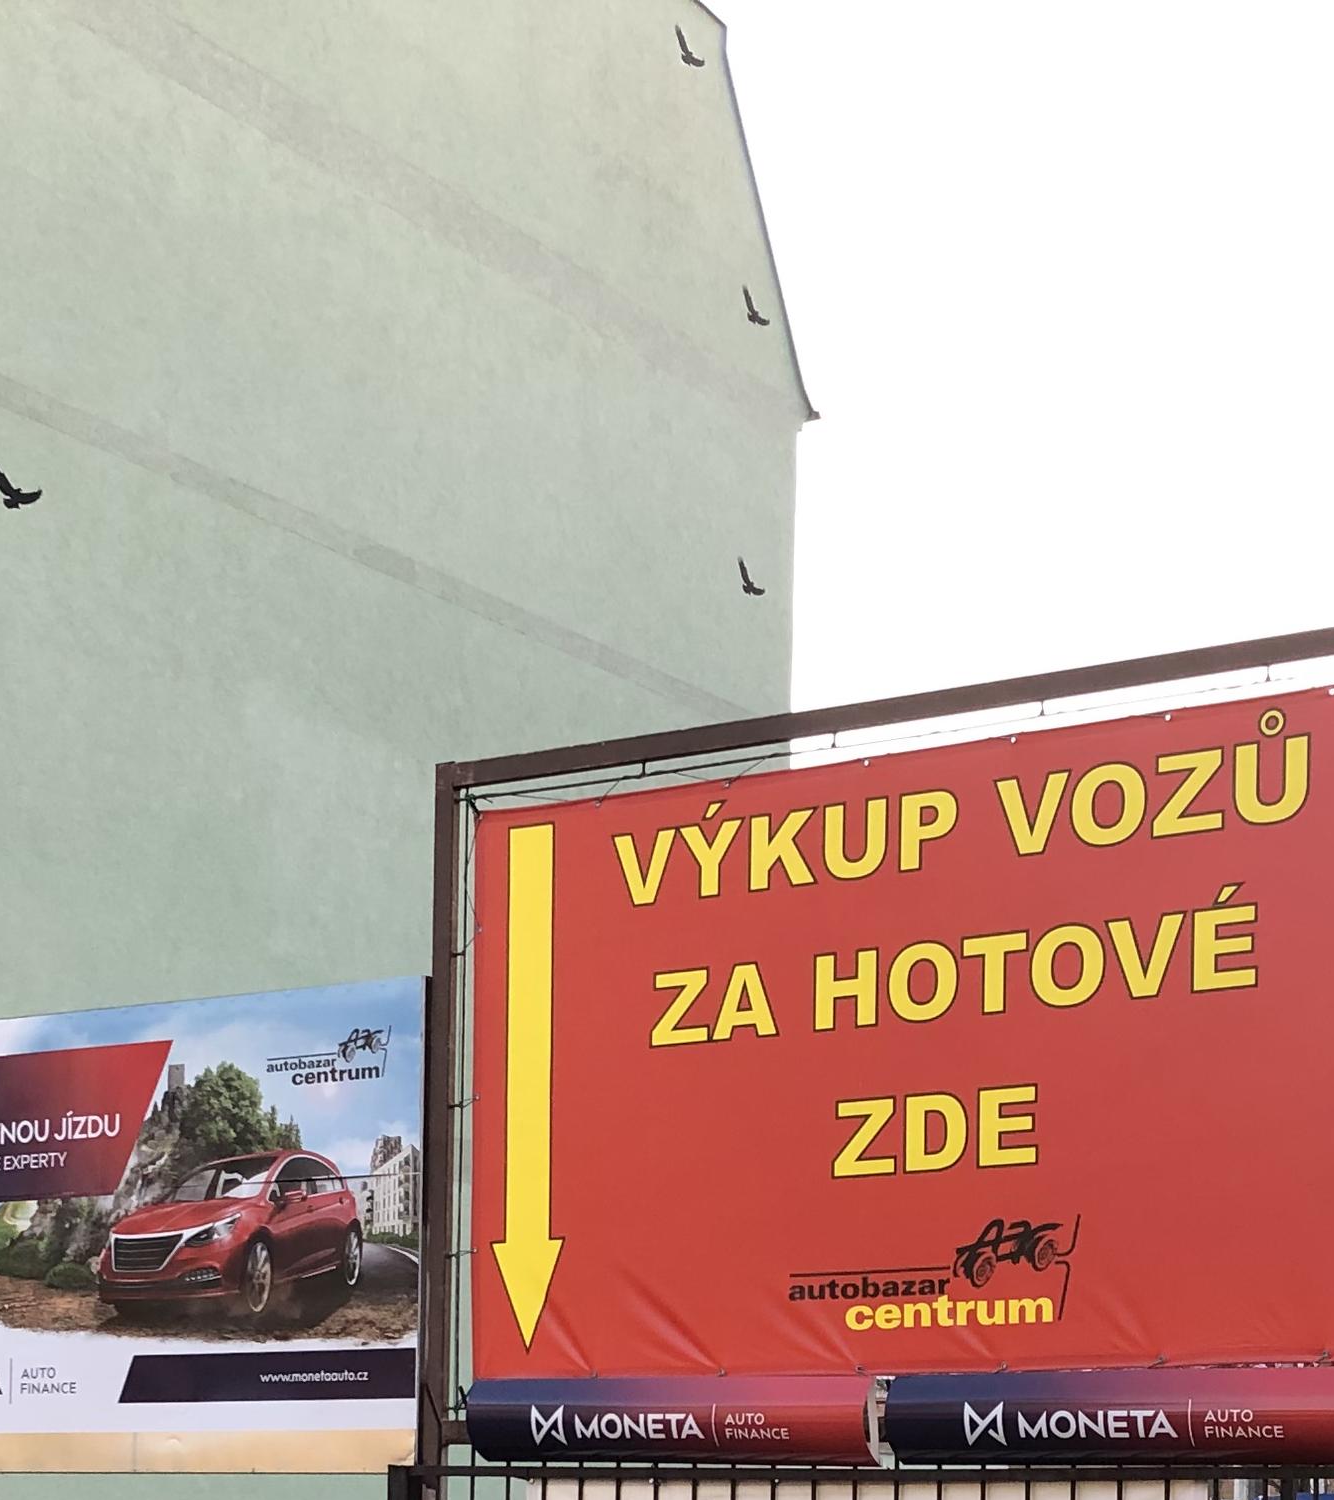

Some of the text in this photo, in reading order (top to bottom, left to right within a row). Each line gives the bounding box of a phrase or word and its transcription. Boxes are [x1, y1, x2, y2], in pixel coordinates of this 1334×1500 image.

[614, 710, 1309, 906] VÝKUP VOZŮ
[652, 886, 1255, 1045] ZA HOTOVÉ
[267, 1058, 337, 1073] autobazar
[292, 1066, 379, 1085] centrum
[54, 1111, 119, 1140] JÍZDU
[834, 1087, 1036, 1176] ZDE
[4, 1152, 67, 1170] EXPERTY
[789, 1277, 950, 1300] autobazar
[846, 1295, 1053, 1330] centrum
[20, 1367, 56, 1379] AUTO
[260, 1370, 368, 1382] www.monetaauto.cz
[20, 1382, 77, 1394] FINANCE
[725, 1413, 764, 1424] AUTO
[1018, 1409, 1177, 1438] MONETA
[1205, 1409, 1253, 1422] AUTO
[575, 1413, 704, 1438] MONETA
[726, 1428, 789, 1439] FINANCE
[1205, 1426, 1283, 1437] FINANCE
